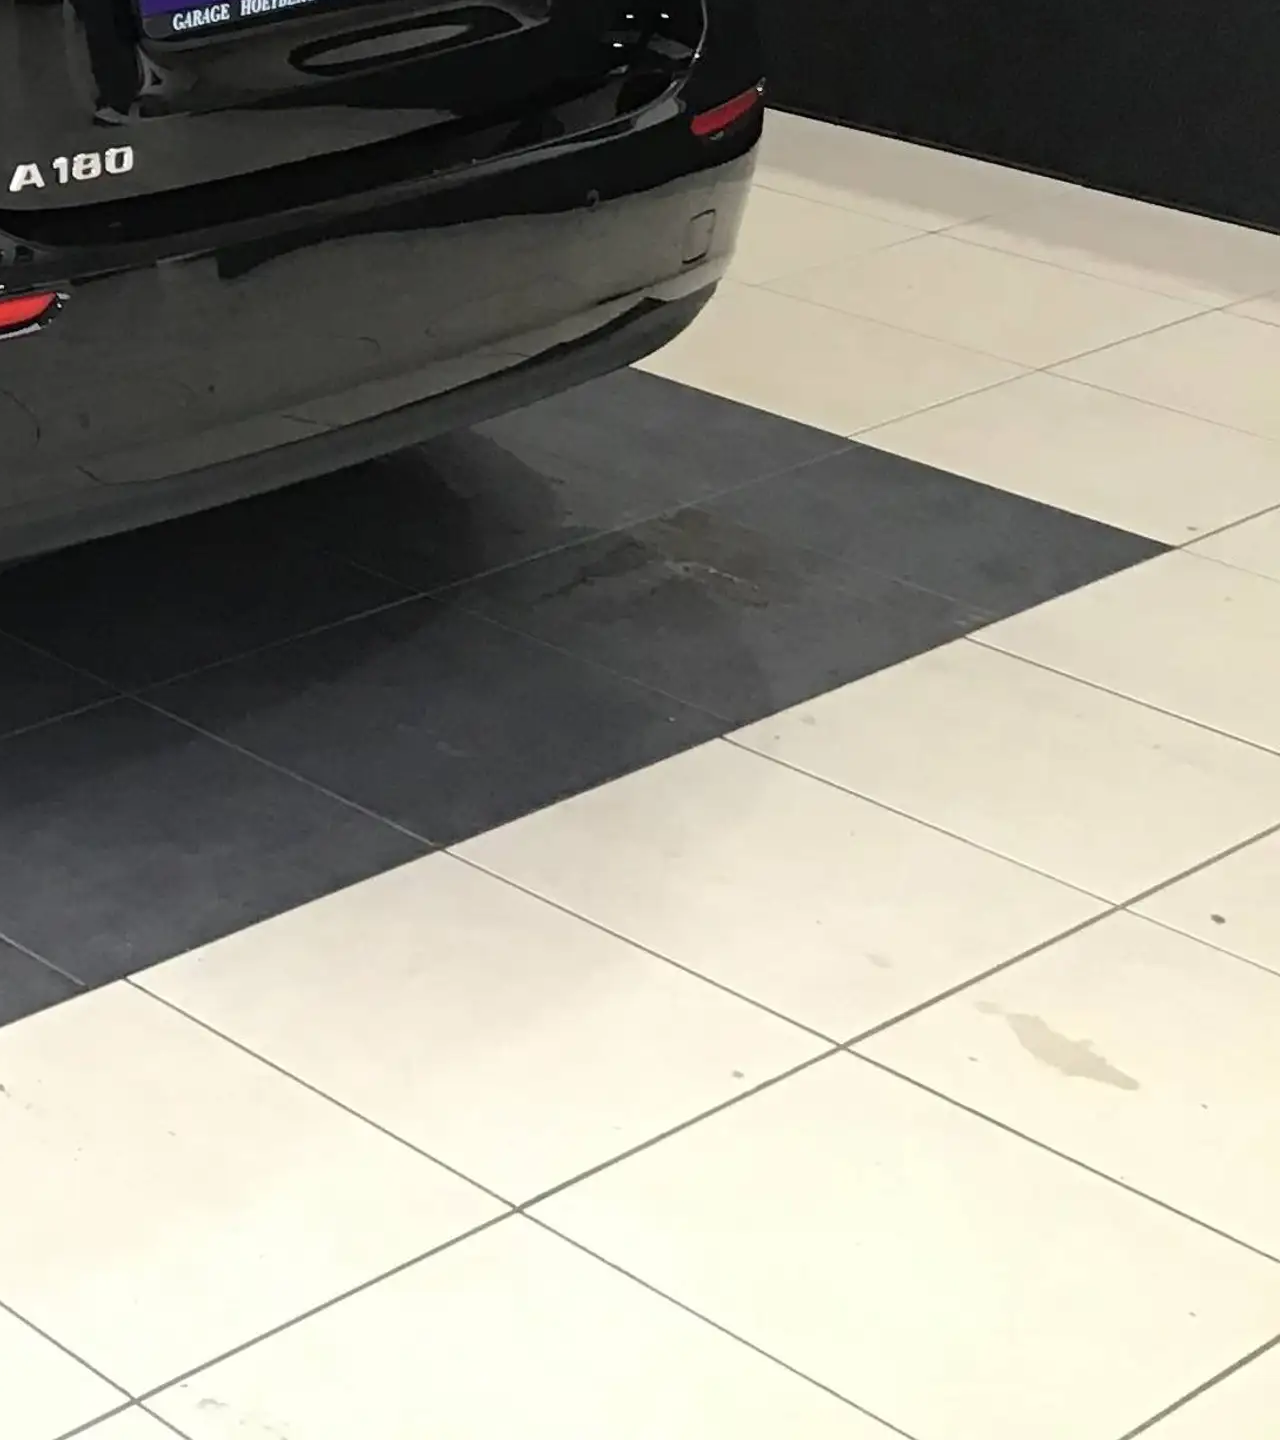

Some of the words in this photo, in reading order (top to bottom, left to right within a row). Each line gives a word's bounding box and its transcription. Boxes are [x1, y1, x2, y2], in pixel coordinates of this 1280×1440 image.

[172, 3, 230, 31] GARAGE
[9, 163, 45, 192] A
[52, 145, 134, 184] 180
